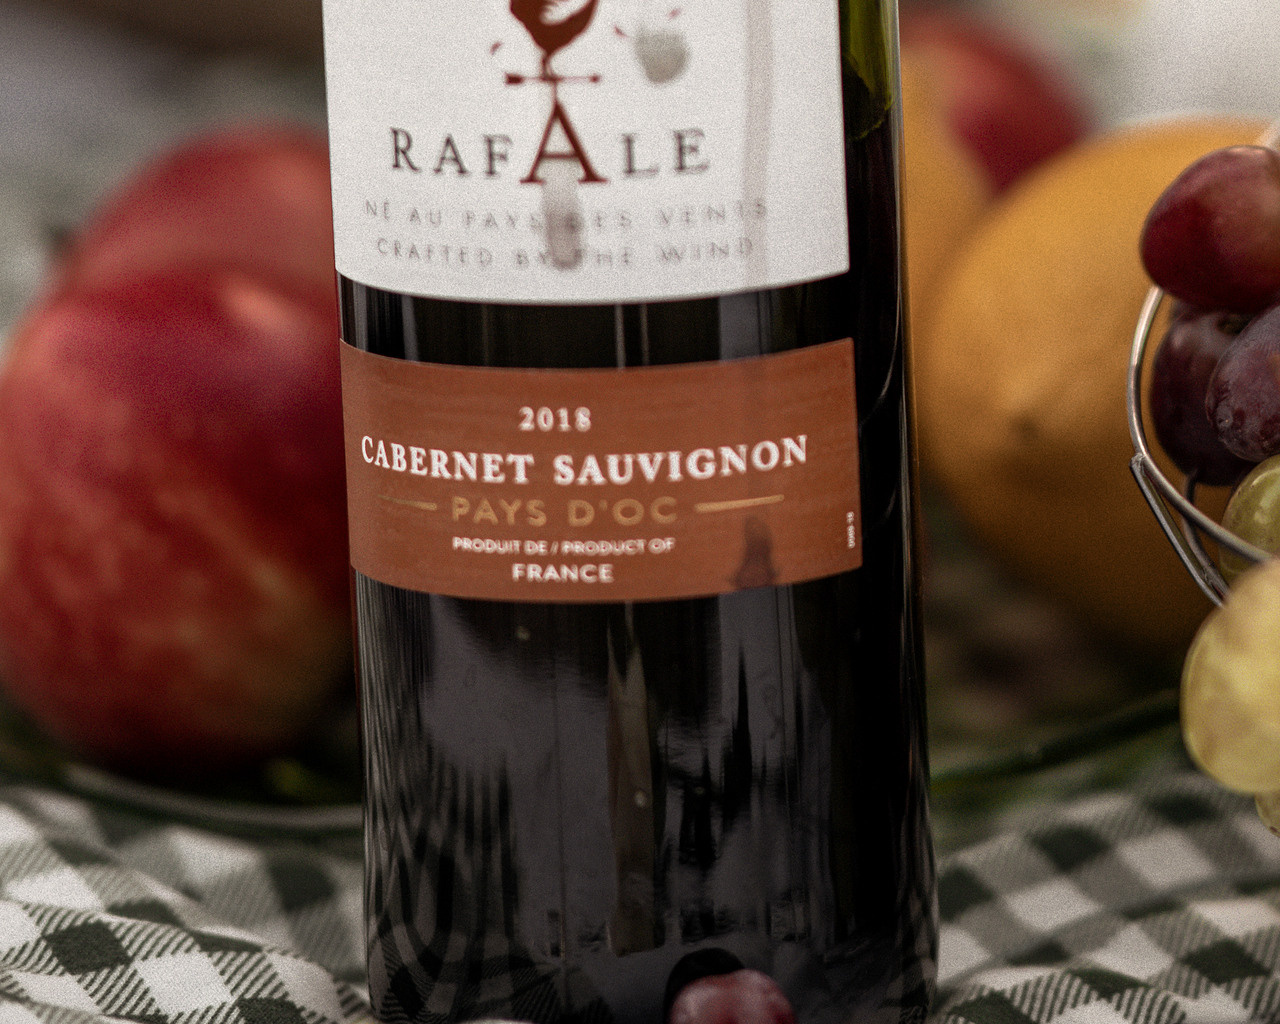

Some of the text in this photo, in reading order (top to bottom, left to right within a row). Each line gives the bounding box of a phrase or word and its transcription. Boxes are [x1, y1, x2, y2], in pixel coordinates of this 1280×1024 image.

[390, 98, 711, 185] RAFALE
[409, 206, 442, 227] AU
[376, 237, 494, 266] CRAFTED
[514, 248, 551, 267] BY
[659, 237, 754, 263] WIND
[518, 406, 592, 432] 2018
[361, 434, 809, 486] CABERNET SAUVIGNON
[452, 495, 678, 527] PAYS D'OC
[452, 536, 521, 555] PRODUIT
[523, 539, 549, 556] DE
[560, 538, 647, 556] PRODUCT
[648, 536, 677, 555] OF
[511, 563, 615, 583] FRANCE
